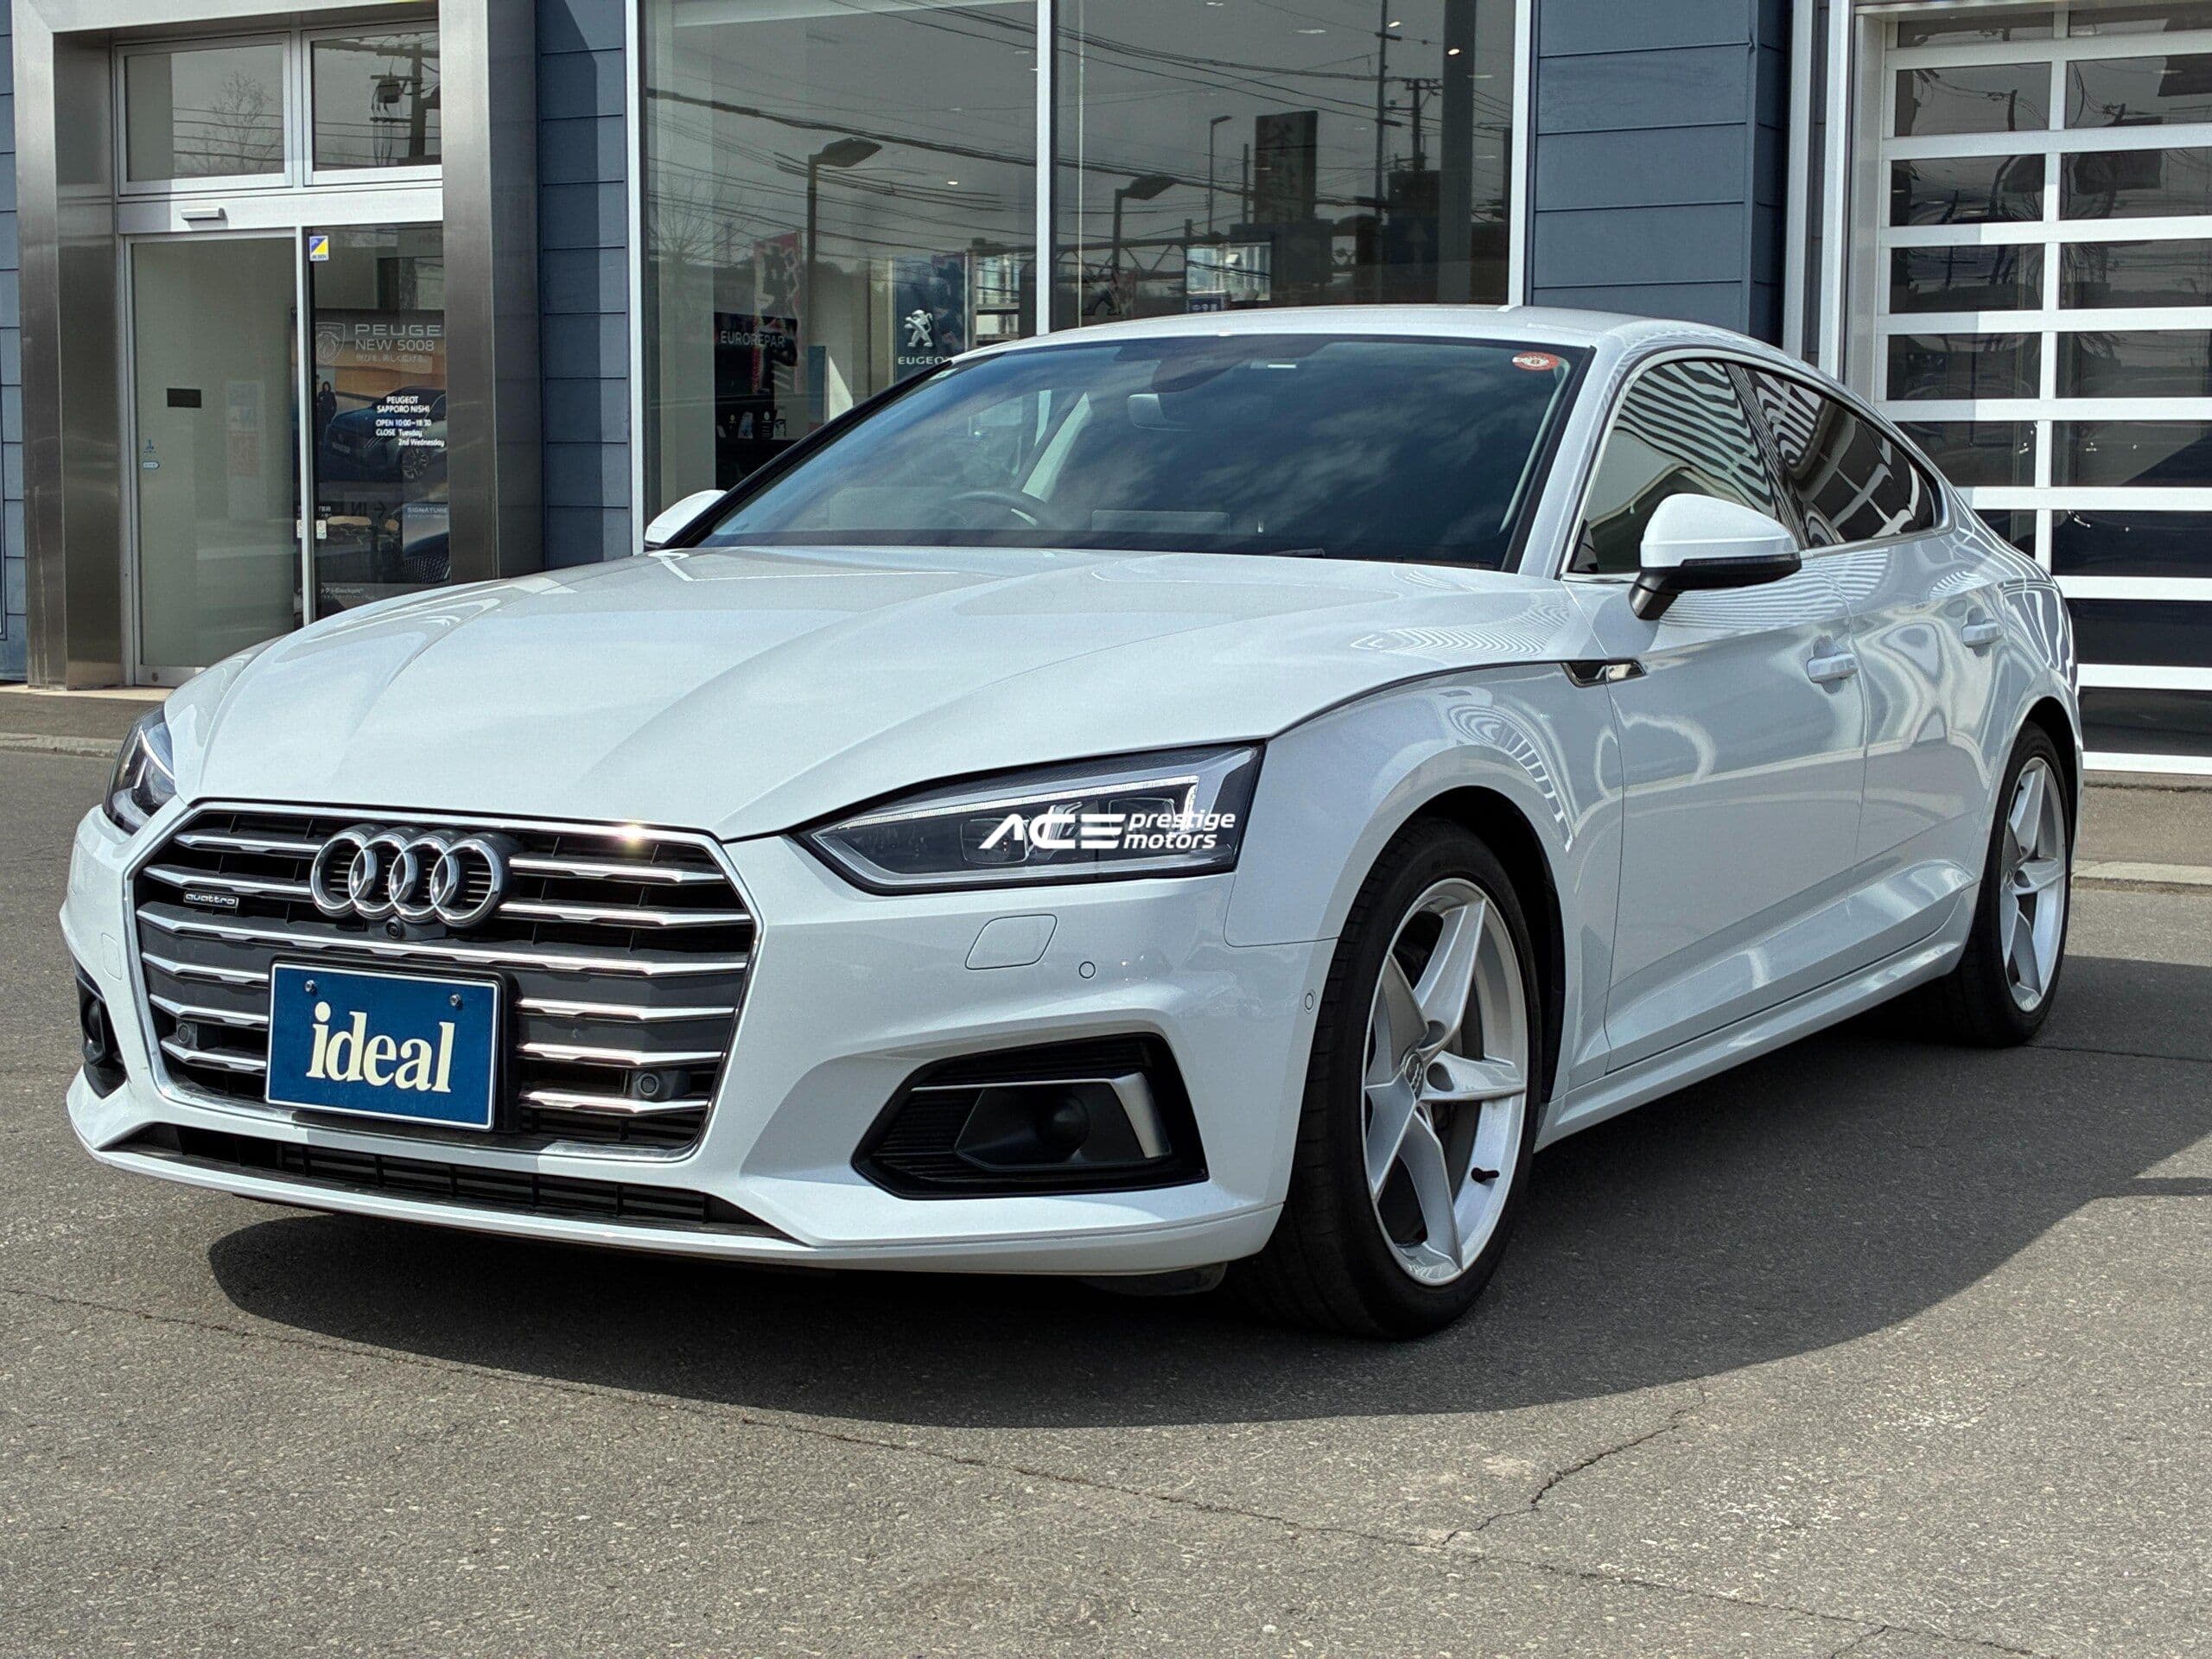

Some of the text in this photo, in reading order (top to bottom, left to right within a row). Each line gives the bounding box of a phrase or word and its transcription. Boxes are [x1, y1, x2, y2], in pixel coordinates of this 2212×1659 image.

[354, 323, 442, 336] PEUGE
[720, 330, 785, 348] EUROREPAR
[355, 339, 435, 352] NEW 5008
[897, 356, 950, 365] EUGEO
[385, 396, 419, 404] PEUGEOT
[376, 404, 430, 414] SAPPORO NISHI
[375, 428, 423, 438] CLOSE Tuesday
[410, 438, 445, 448] Wednesday
[185, 893, 236, 906] quattro
[305, 1001, 455, 1093] ideal
